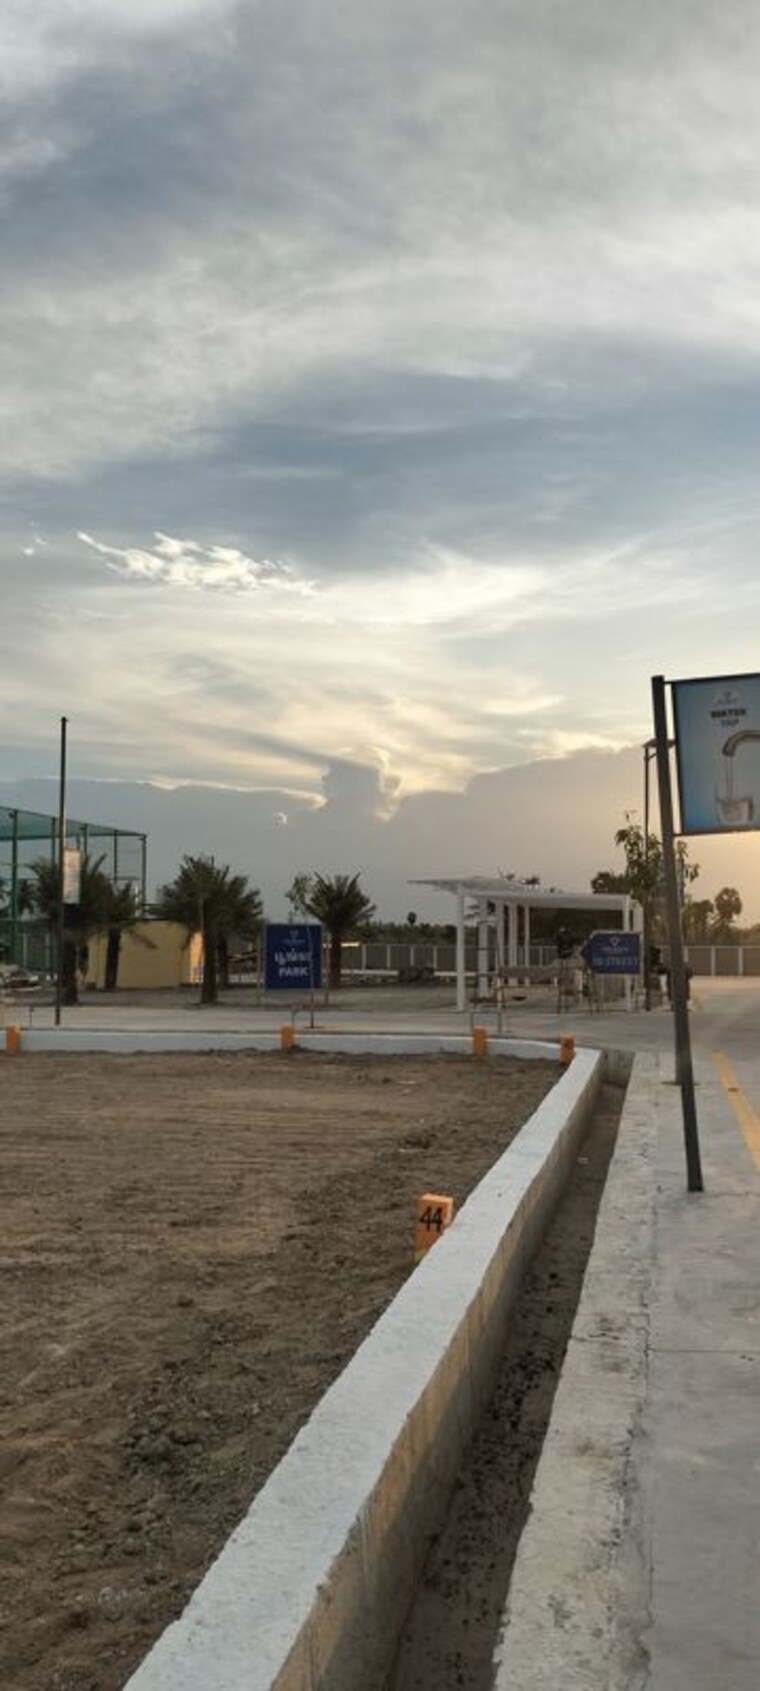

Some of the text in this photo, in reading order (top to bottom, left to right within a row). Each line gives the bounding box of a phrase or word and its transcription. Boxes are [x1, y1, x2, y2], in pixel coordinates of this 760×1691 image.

[711, 708, 746, 718] WATER
[279, 966, 308, 977] PARK
[420, 1206, 443, 1231] 44
